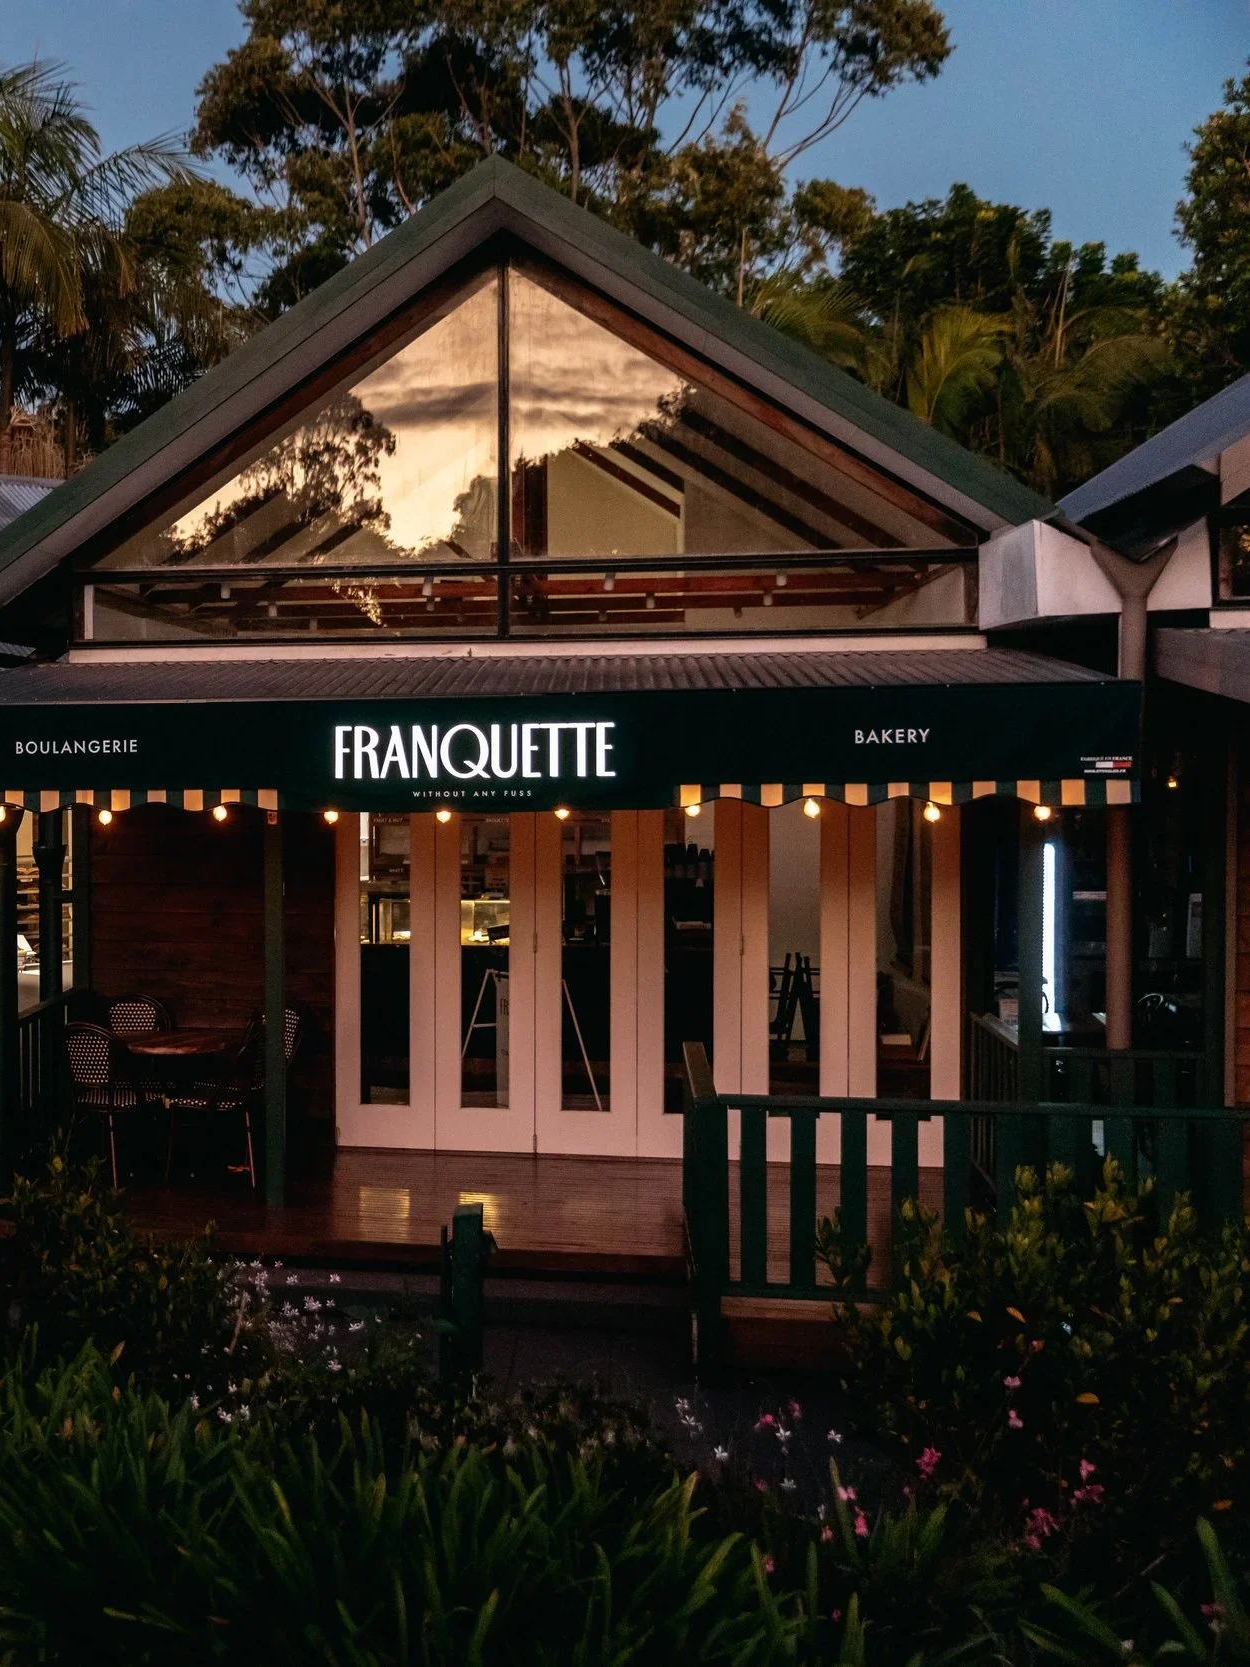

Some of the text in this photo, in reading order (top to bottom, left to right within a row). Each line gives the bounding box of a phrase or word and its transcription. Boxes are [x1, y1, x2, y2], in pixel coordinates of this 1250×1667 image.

[854, 728, 930, 744] BAKERY
[15, 739, 138, 755] BOULANGERIE
[334, 722, 617, 779] FRANQUETTE
[412, 790, 466, 798] WITHOUT
[503, 789, 532, 797] FUSS
